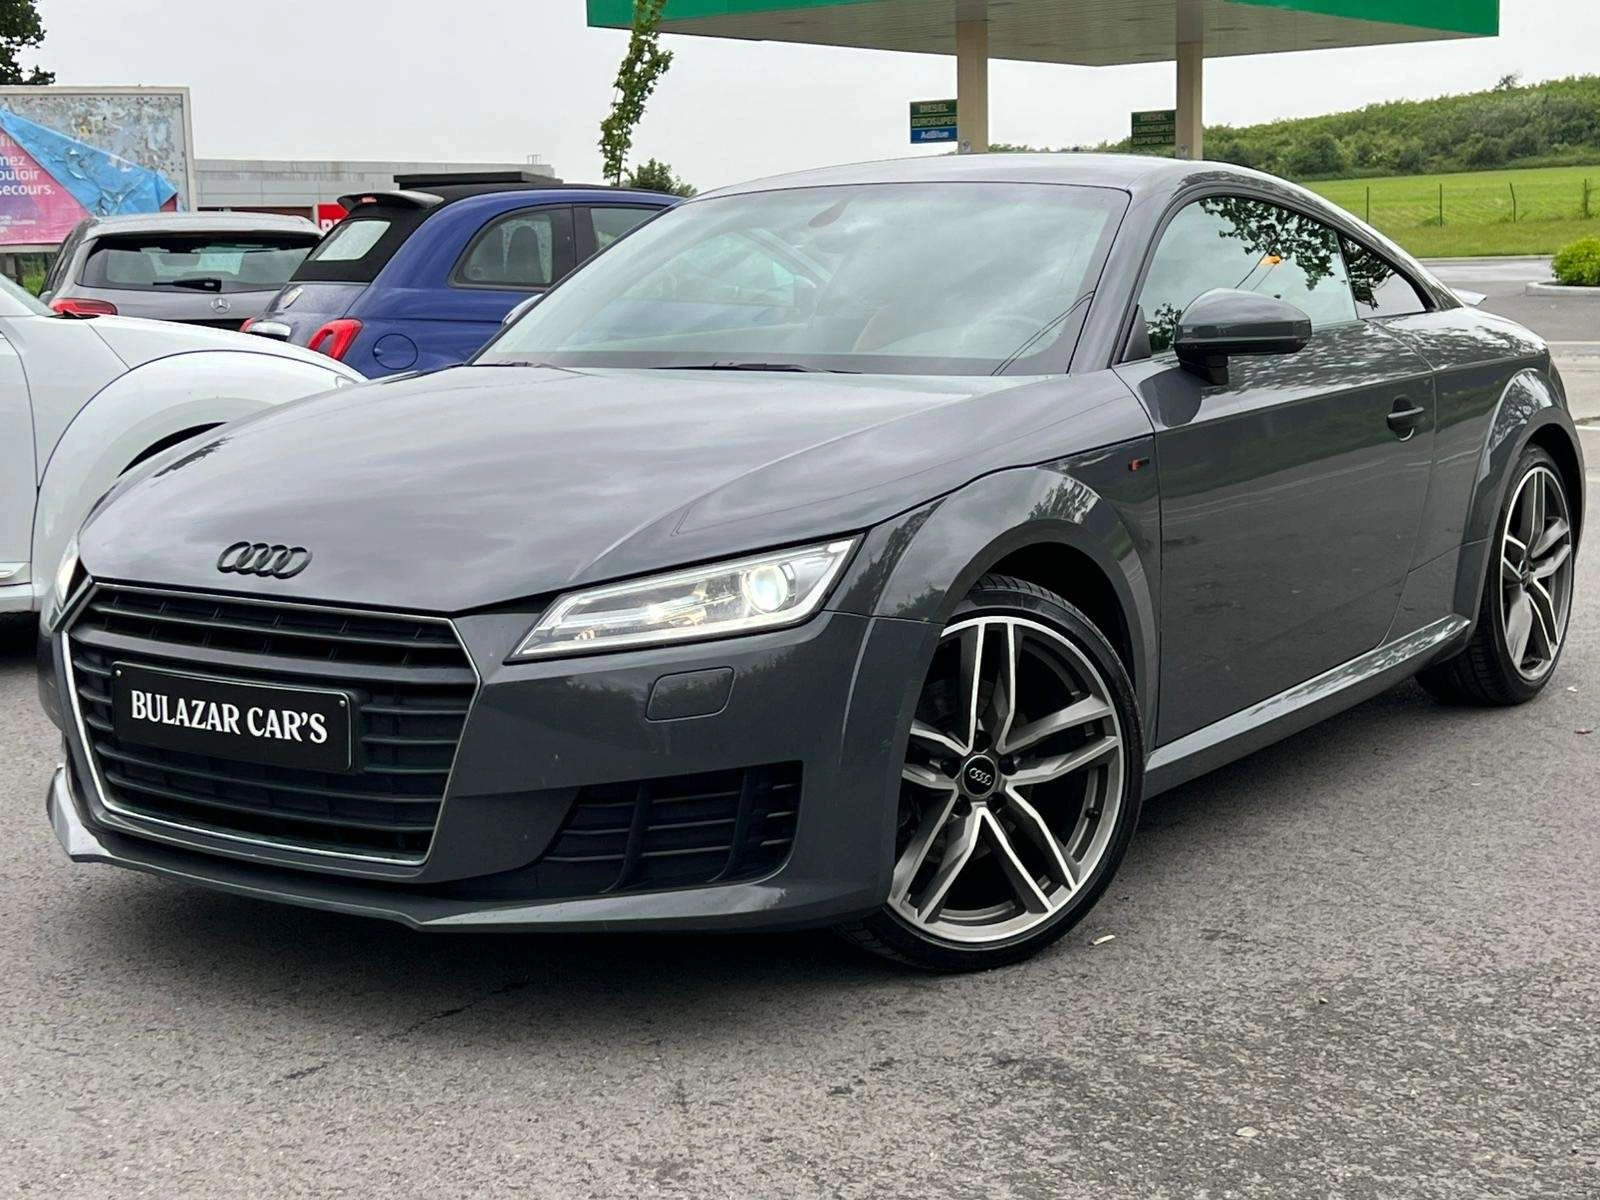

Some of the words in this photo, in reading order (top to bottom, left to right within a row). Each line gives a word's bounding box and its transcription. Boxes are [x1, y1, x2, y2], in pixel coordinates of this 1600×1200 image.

[920, 103, 949, 113] DIESEL
[0, 184, 56, 196] ecours.
[131, 690, 241, 735] BULAZAR
[247, 707, 328, 744] CAR'S
